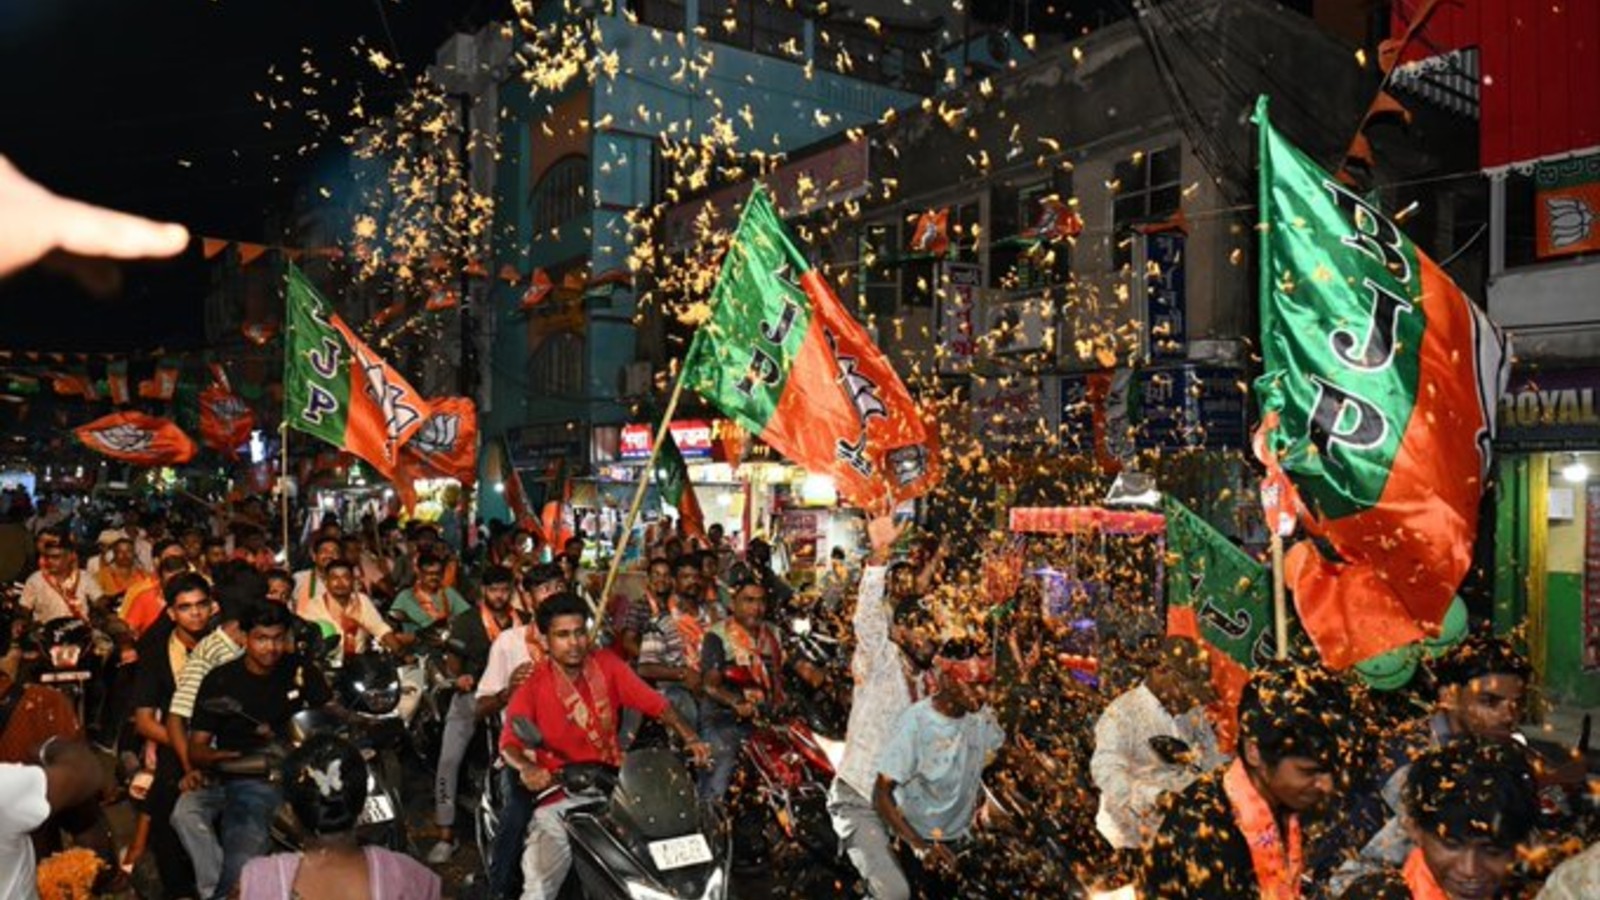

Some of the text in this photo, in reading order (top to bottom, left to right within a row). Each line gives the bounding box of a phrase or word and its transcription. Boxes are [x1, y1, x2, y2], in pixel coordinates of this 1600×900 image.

[302, 285, 342, 425] JP
[734, 262, 806, 397] JP
[1308, 178, 1413, 469] BJP
